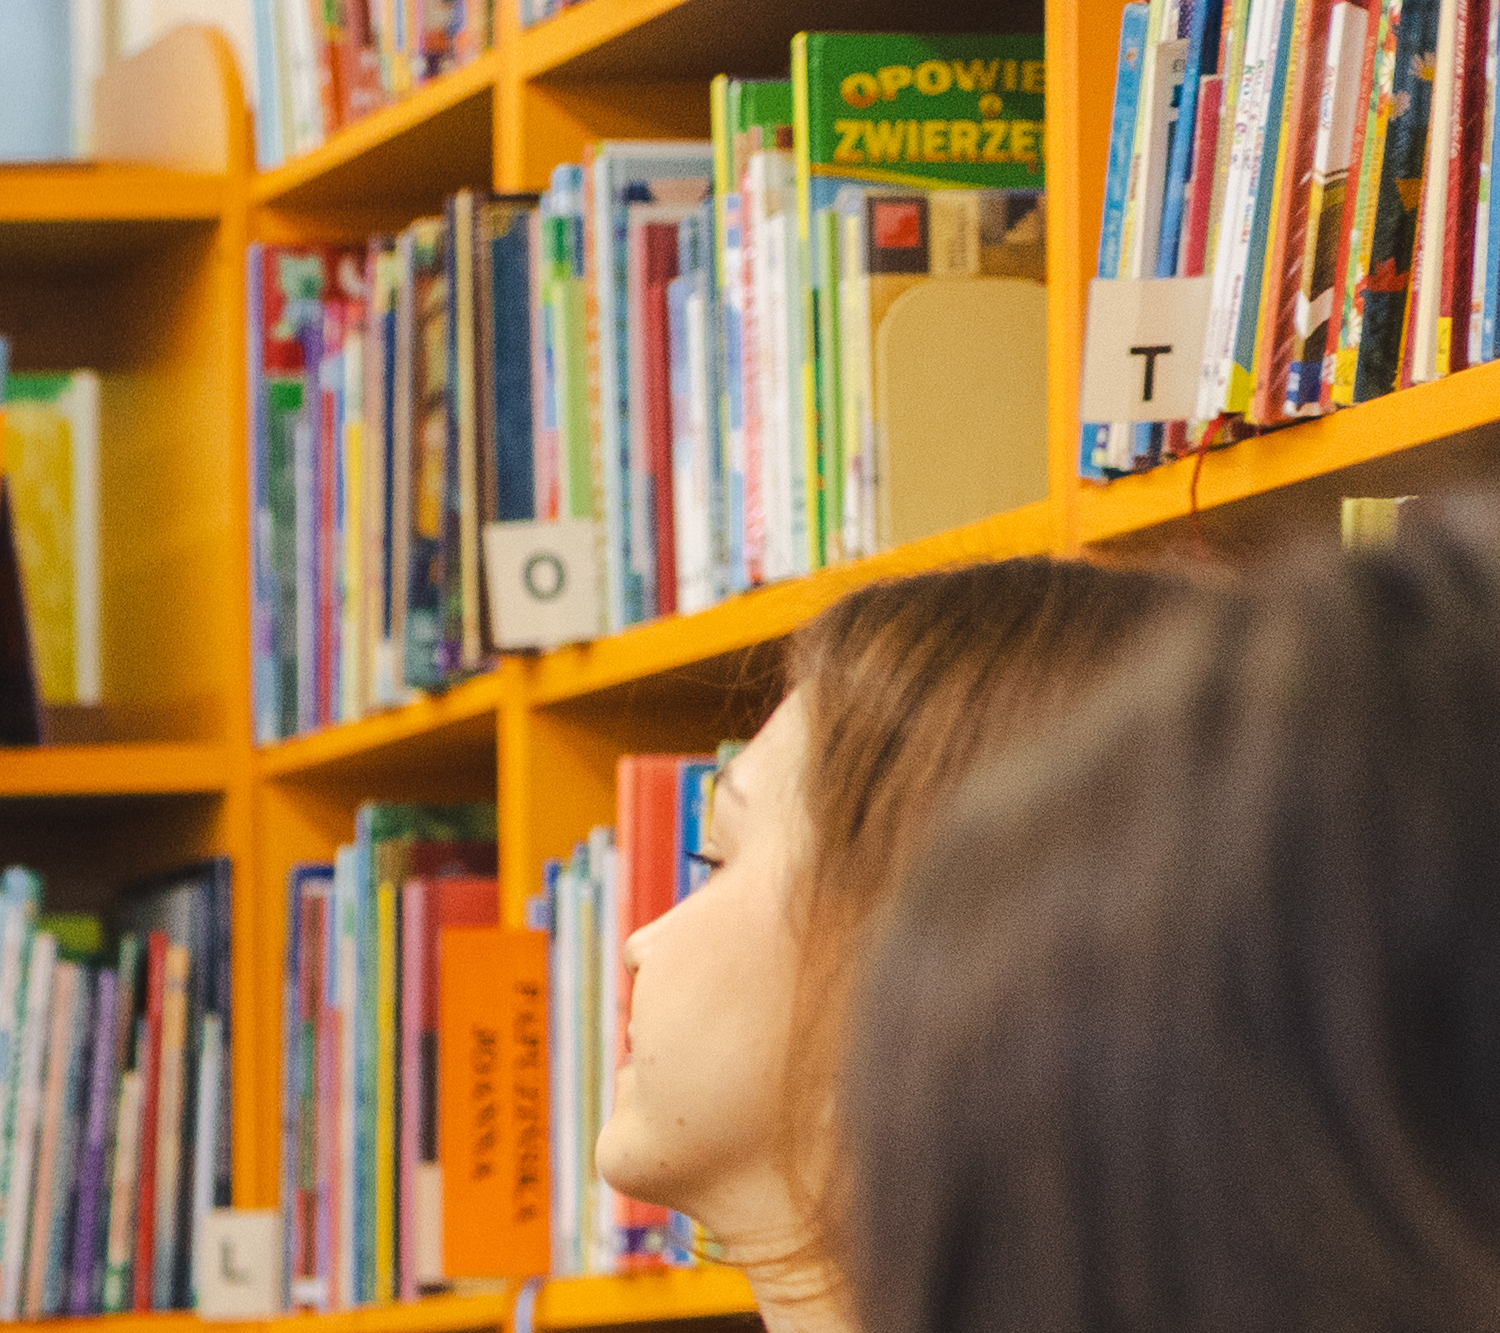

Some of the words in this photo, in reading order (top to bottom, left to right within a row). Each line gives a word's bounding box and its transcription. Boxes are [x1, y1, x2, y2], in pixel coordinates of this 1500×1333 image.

[833, 119, 1045, 174] ZWIERZĘ
[1130, 345, 1172, 401] T
[523, 552, 566, 602] O
